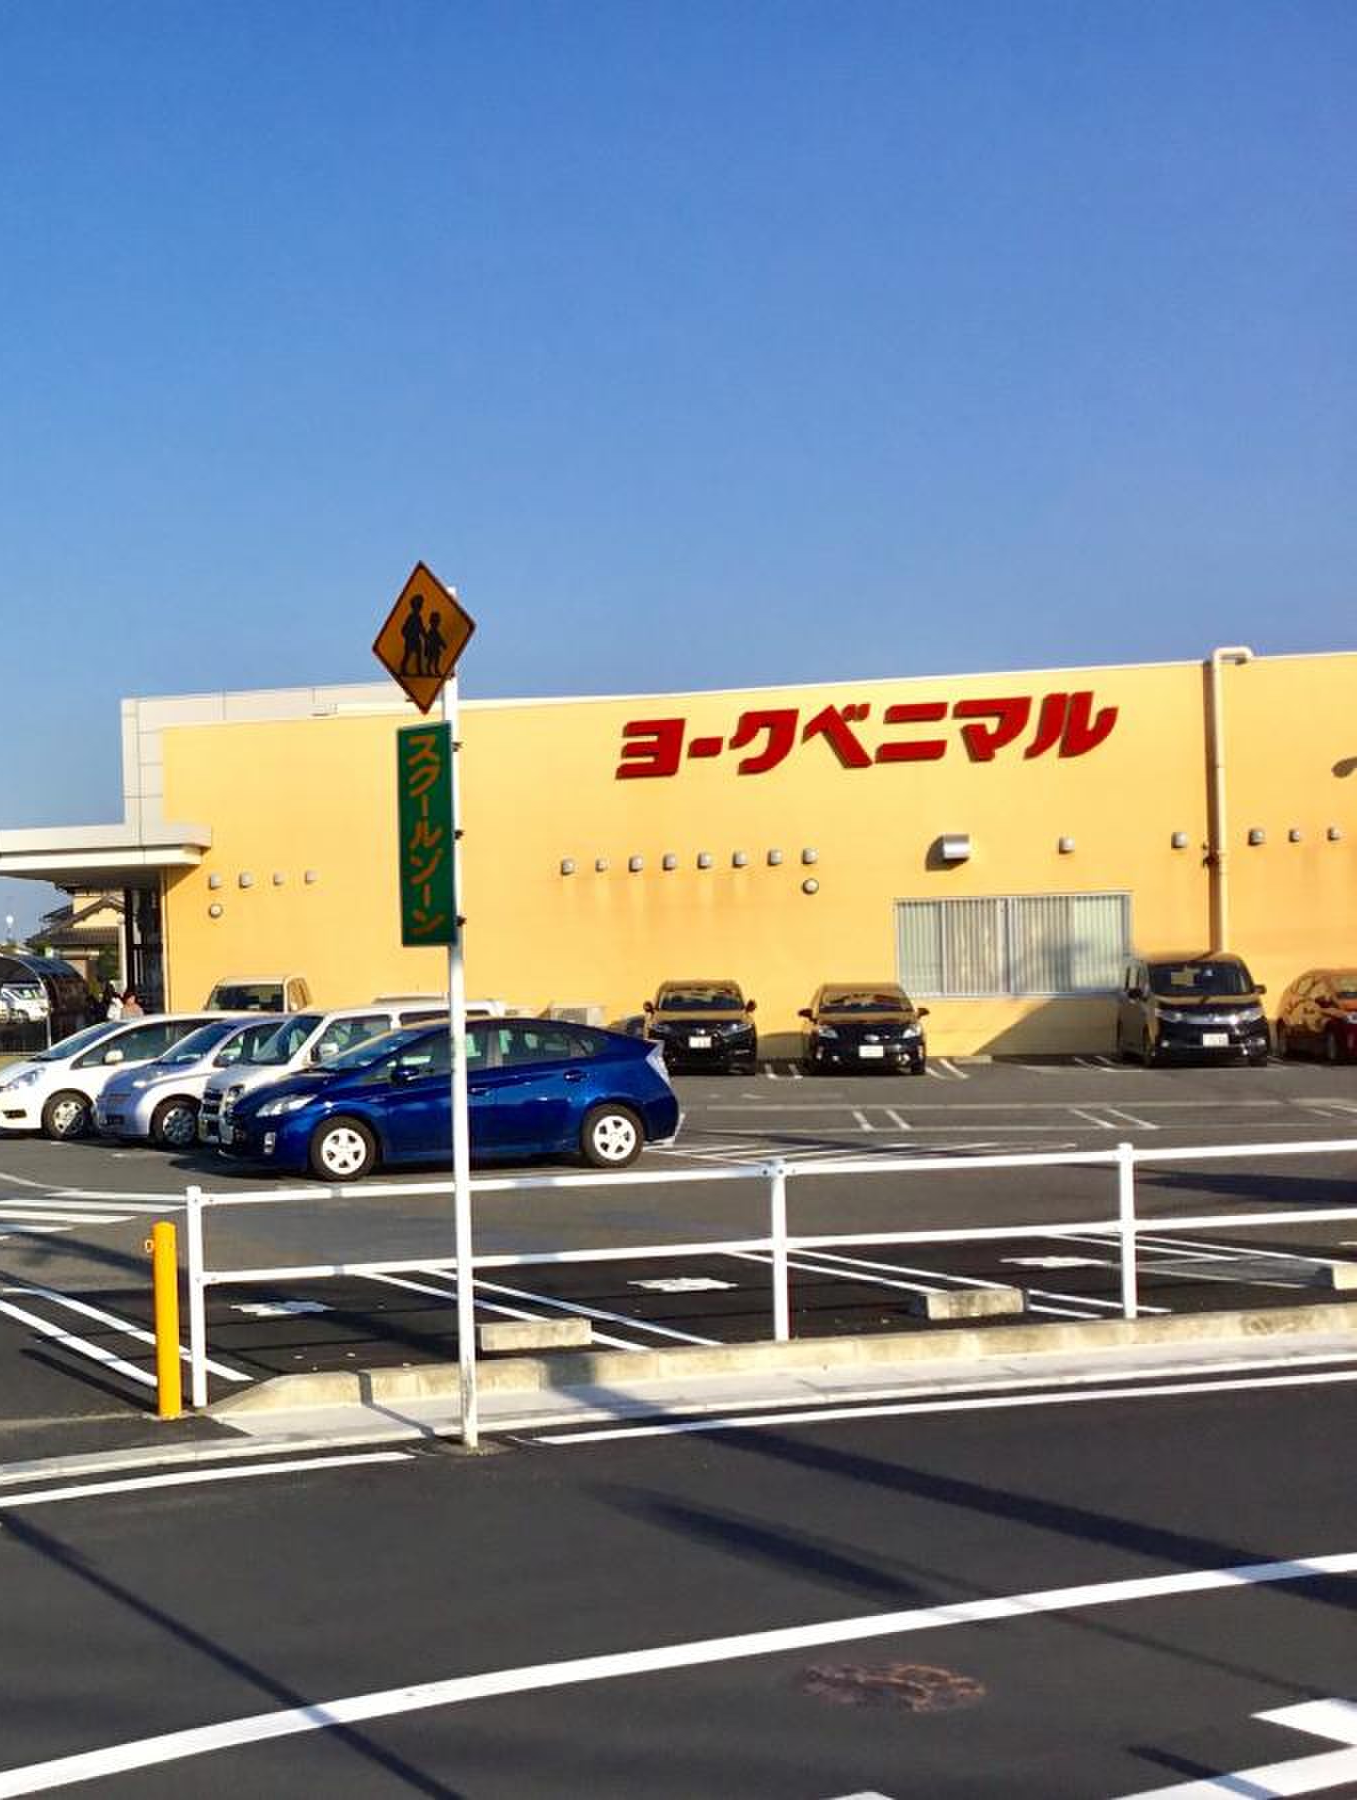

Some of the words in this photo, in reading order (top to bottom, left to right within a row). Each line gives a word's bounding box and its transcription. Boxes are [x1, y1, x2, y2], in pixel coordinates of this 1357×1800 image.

[615, 691, 1118, 779] ヨークベニマル
